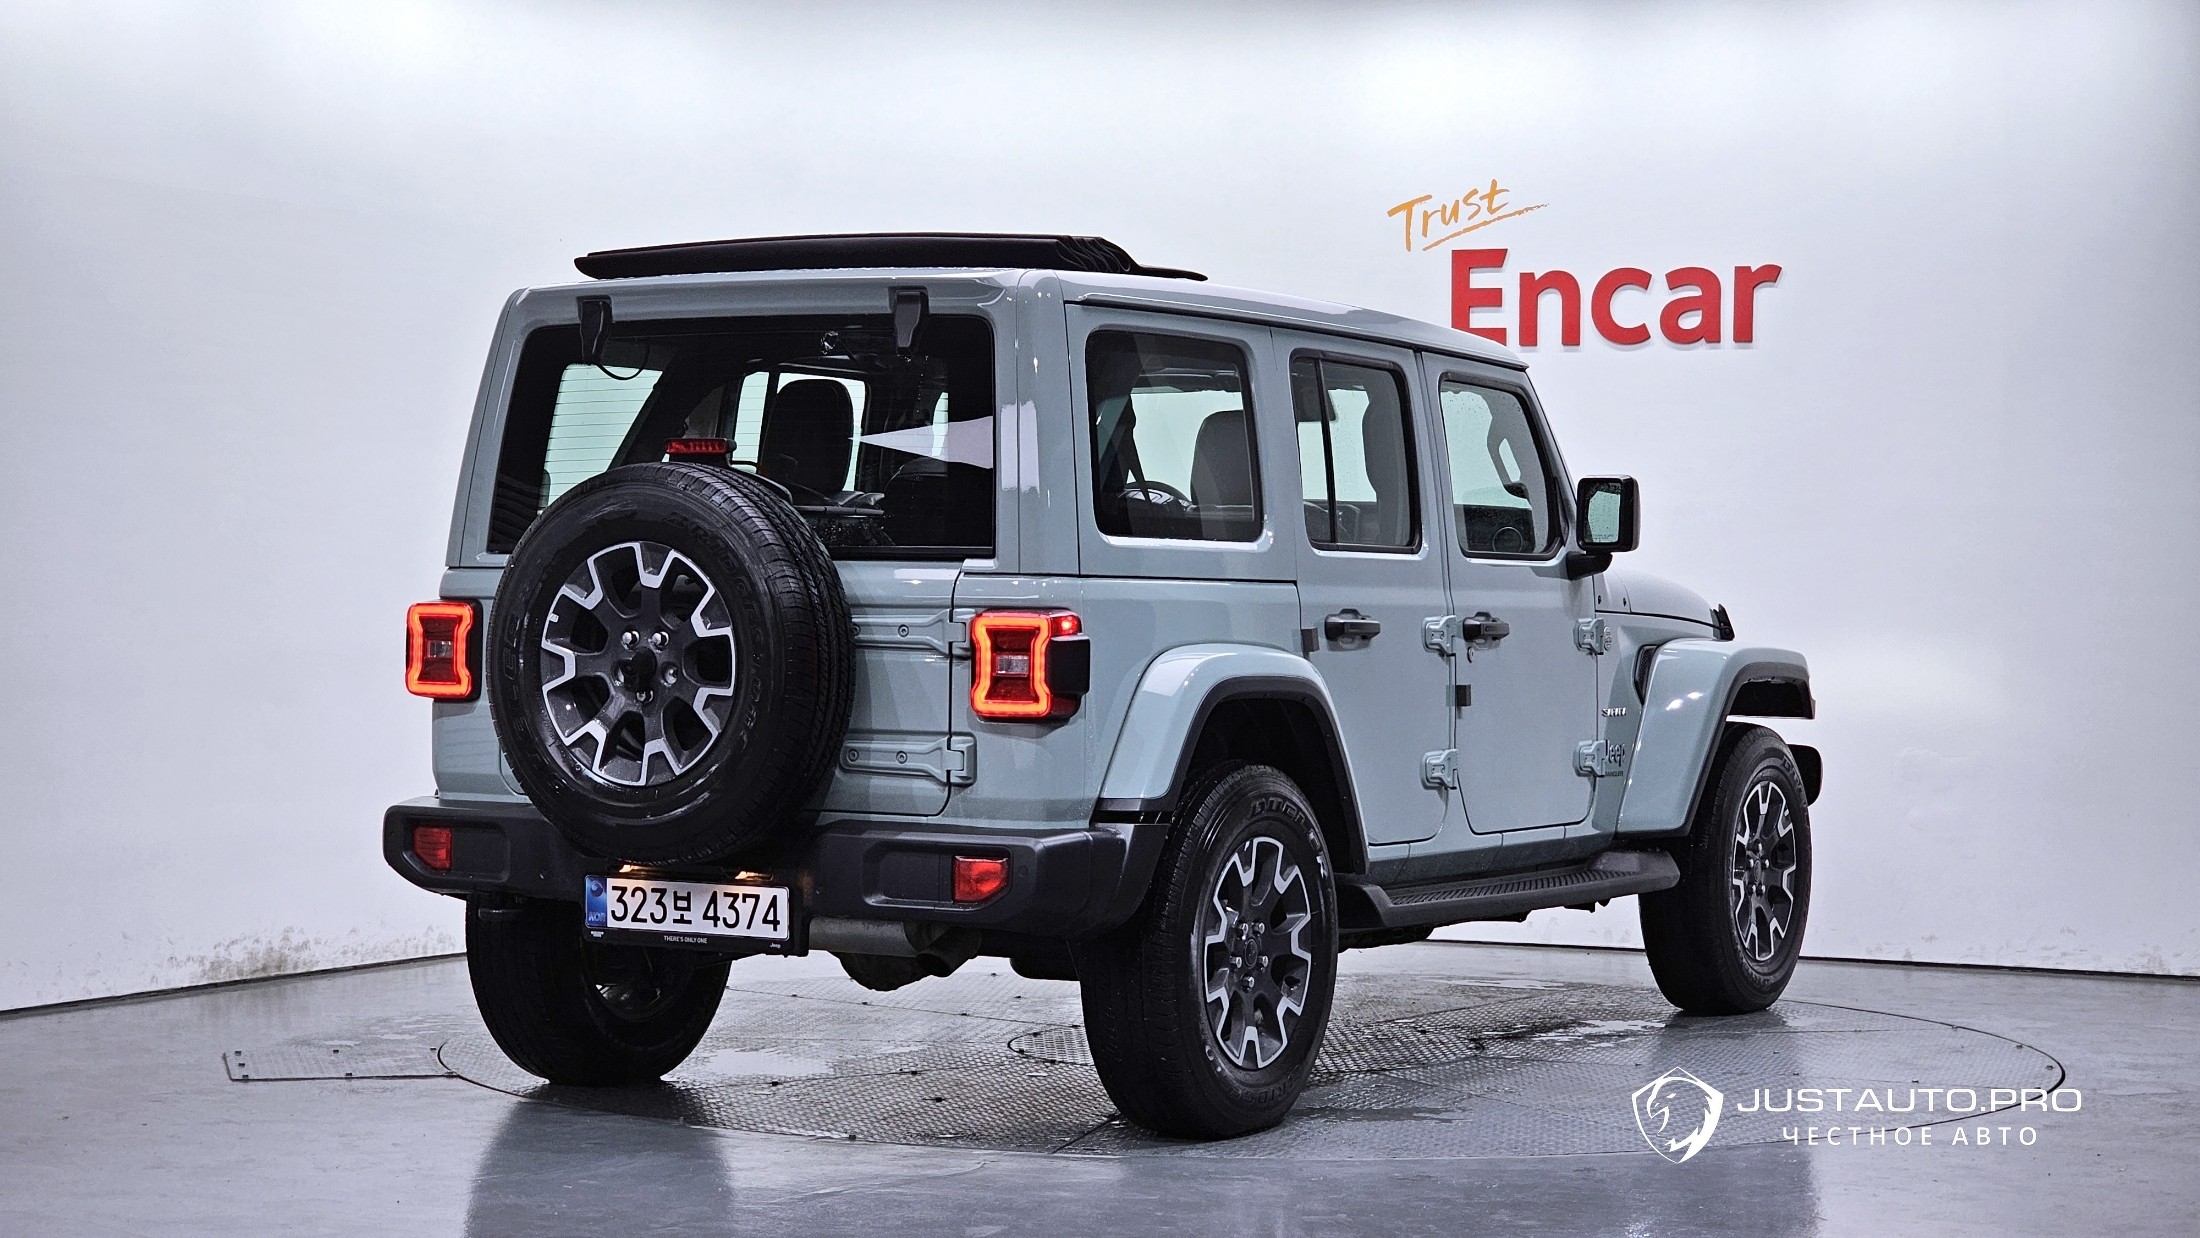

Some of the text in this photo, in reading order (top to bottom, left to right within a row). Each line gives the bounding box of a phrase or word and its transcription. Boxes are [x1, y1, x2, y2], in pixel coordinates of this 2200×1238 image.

[1387, 178, 1510, 252] Trust
[1451, 248, 1783, 347] Encar
[610, 885, 781, 932] 323보 4374
